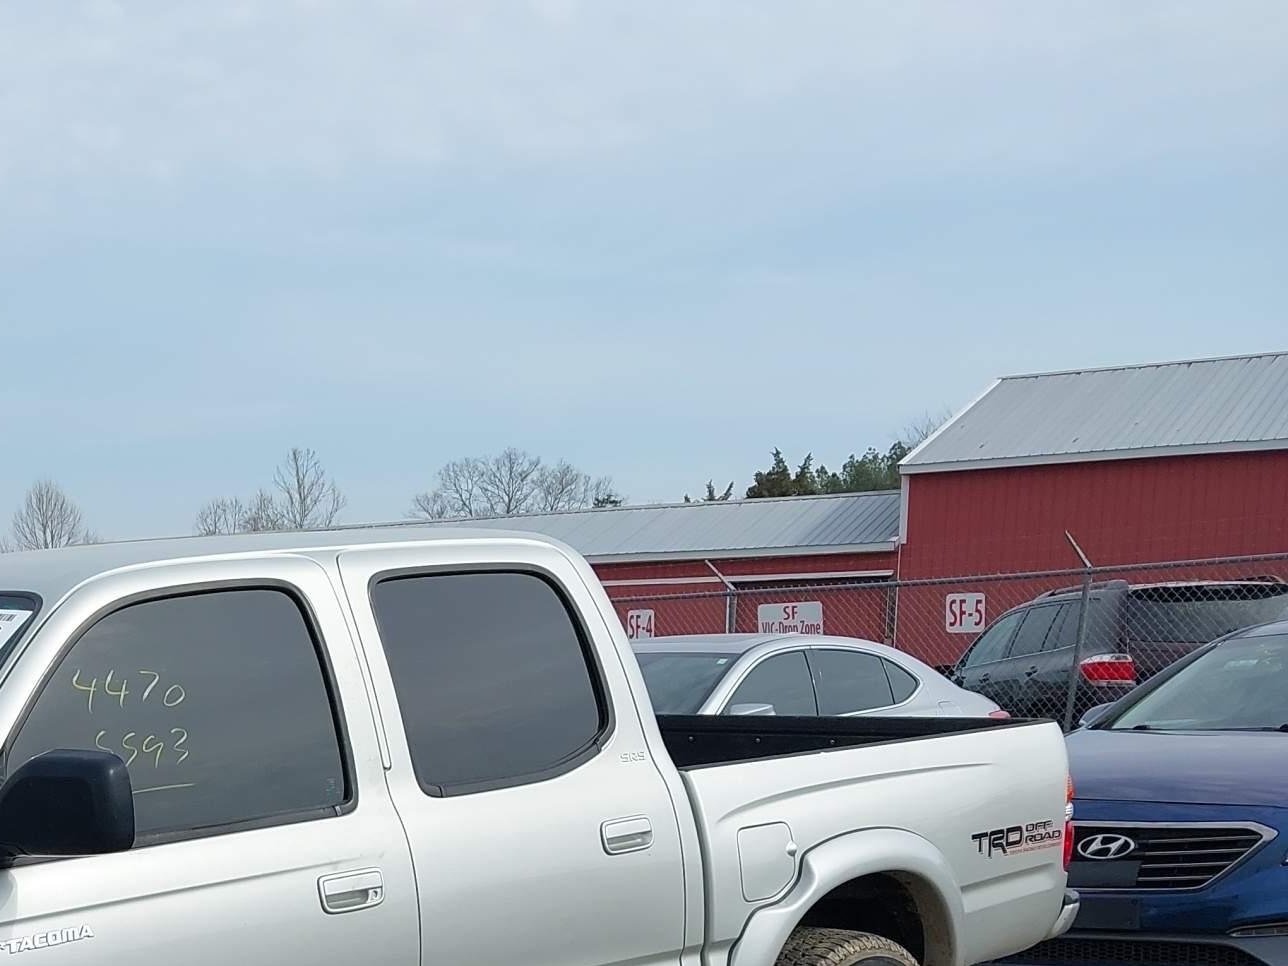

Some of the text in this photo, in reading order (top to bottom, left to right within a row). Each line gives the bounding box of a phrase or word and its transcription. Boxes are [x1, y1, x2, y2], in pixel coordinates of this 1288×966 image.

[783, 606, 798, 620] SF
[949, 599, 983, 627] SF-5
[629, 615, 653, 639] SF-4
[800, 620, 821, 635] Zone
[73, 669, 186, 713] 4470
[1025, 820, 1053, 832] OFF
[1025, 830, 1062, 844] ROAD
[971, 826, 1023, 857] TRD
[6, 922, 94, 955] TACOMA
